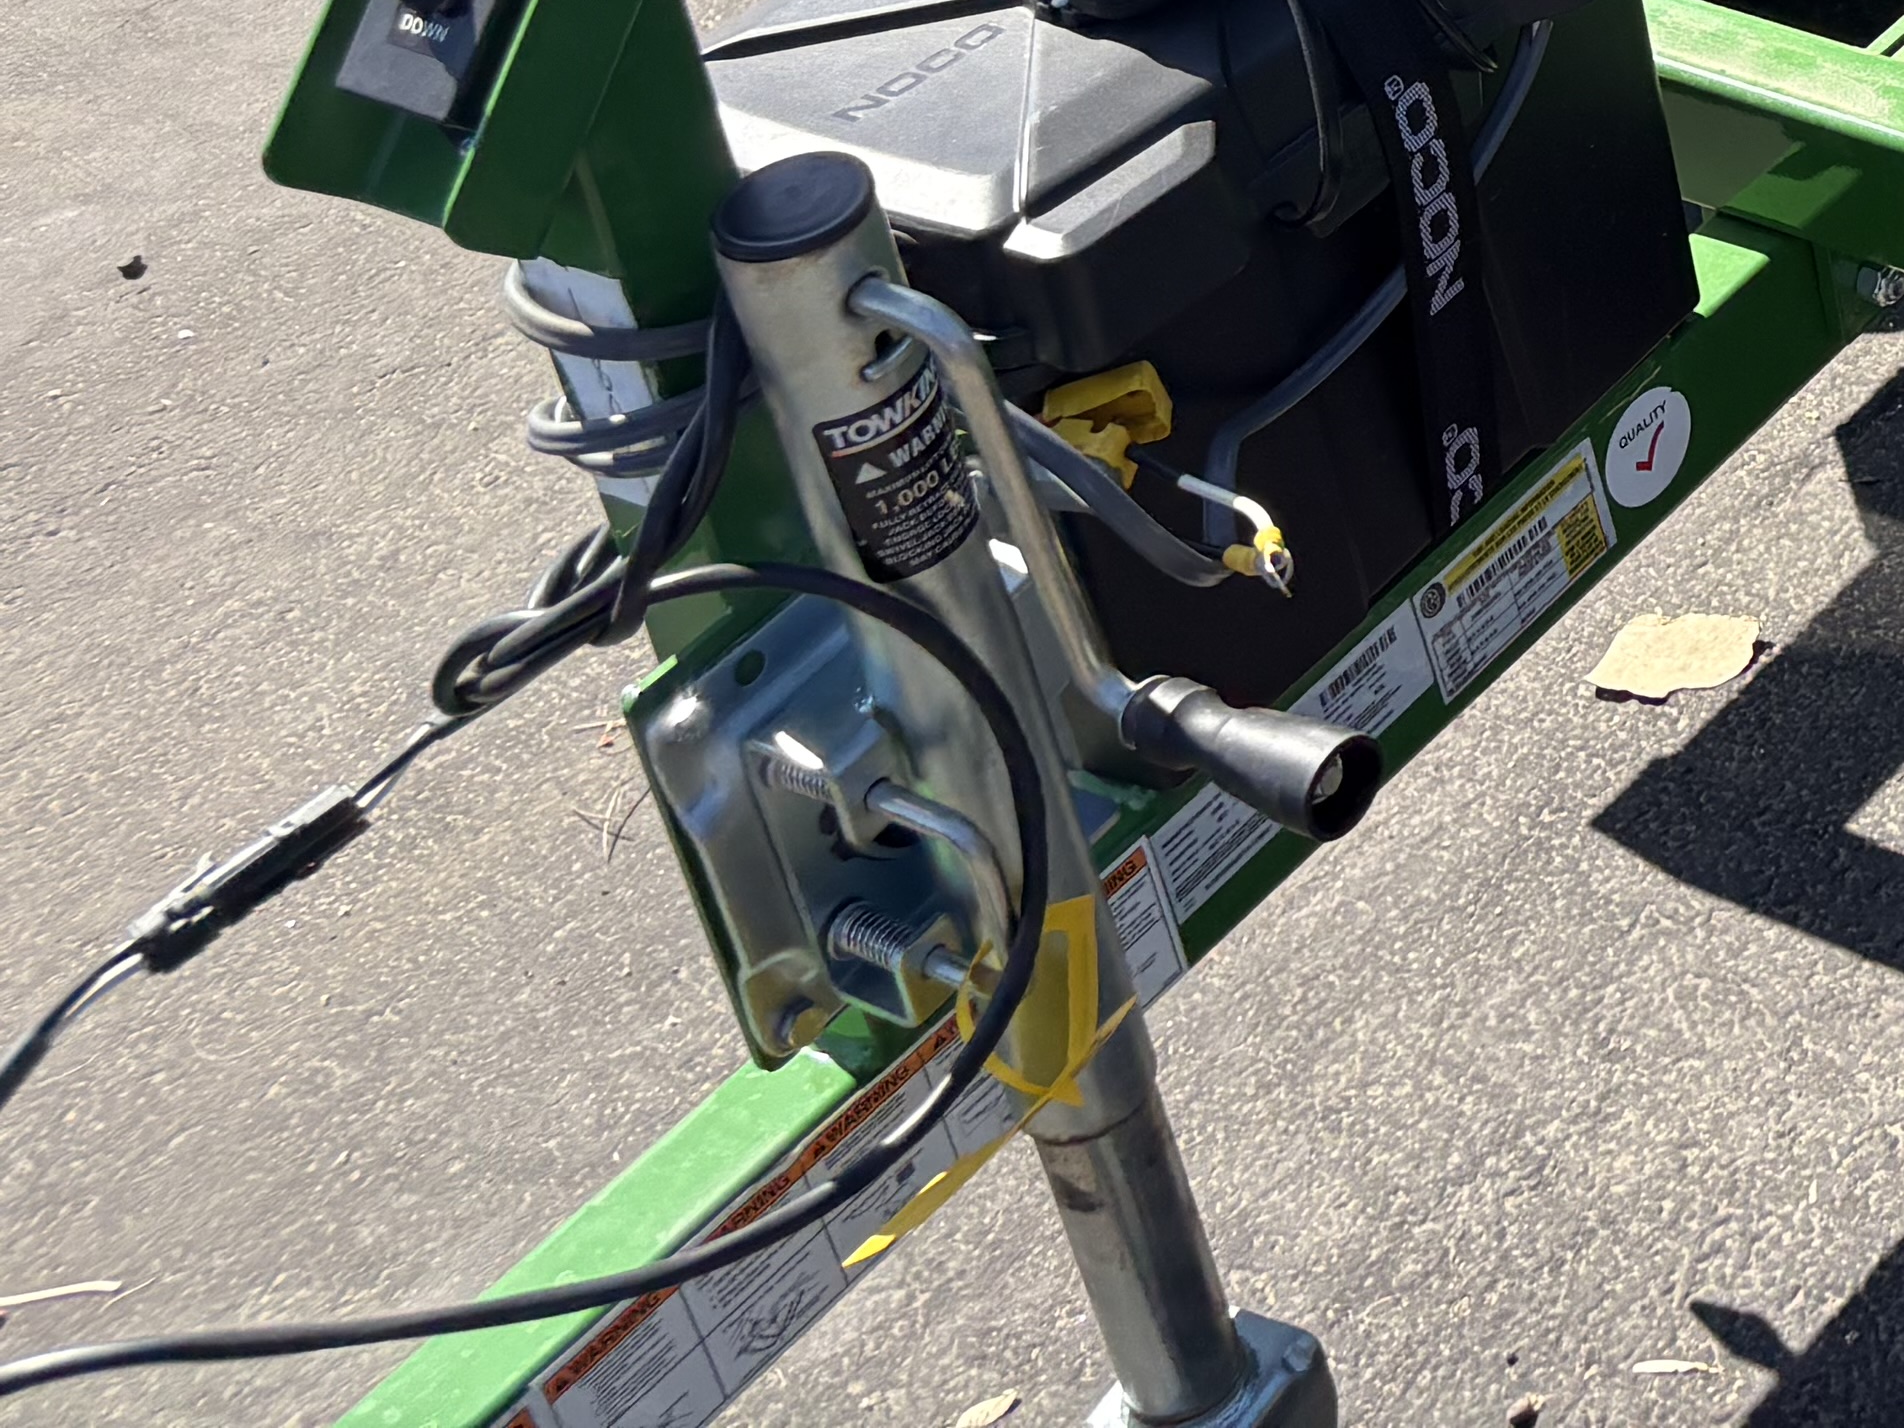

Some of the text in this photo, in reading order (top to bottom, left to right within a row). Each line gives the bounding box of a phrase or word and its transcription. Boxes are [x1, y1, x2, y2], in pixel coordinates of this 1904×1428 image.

[399, 13, 450, 43] DOWN
[830, 22, 1007, 123] NOCO
[1618, 400, 1667, 449] QUALITY
[874, 470, 940, 515] 1,000
